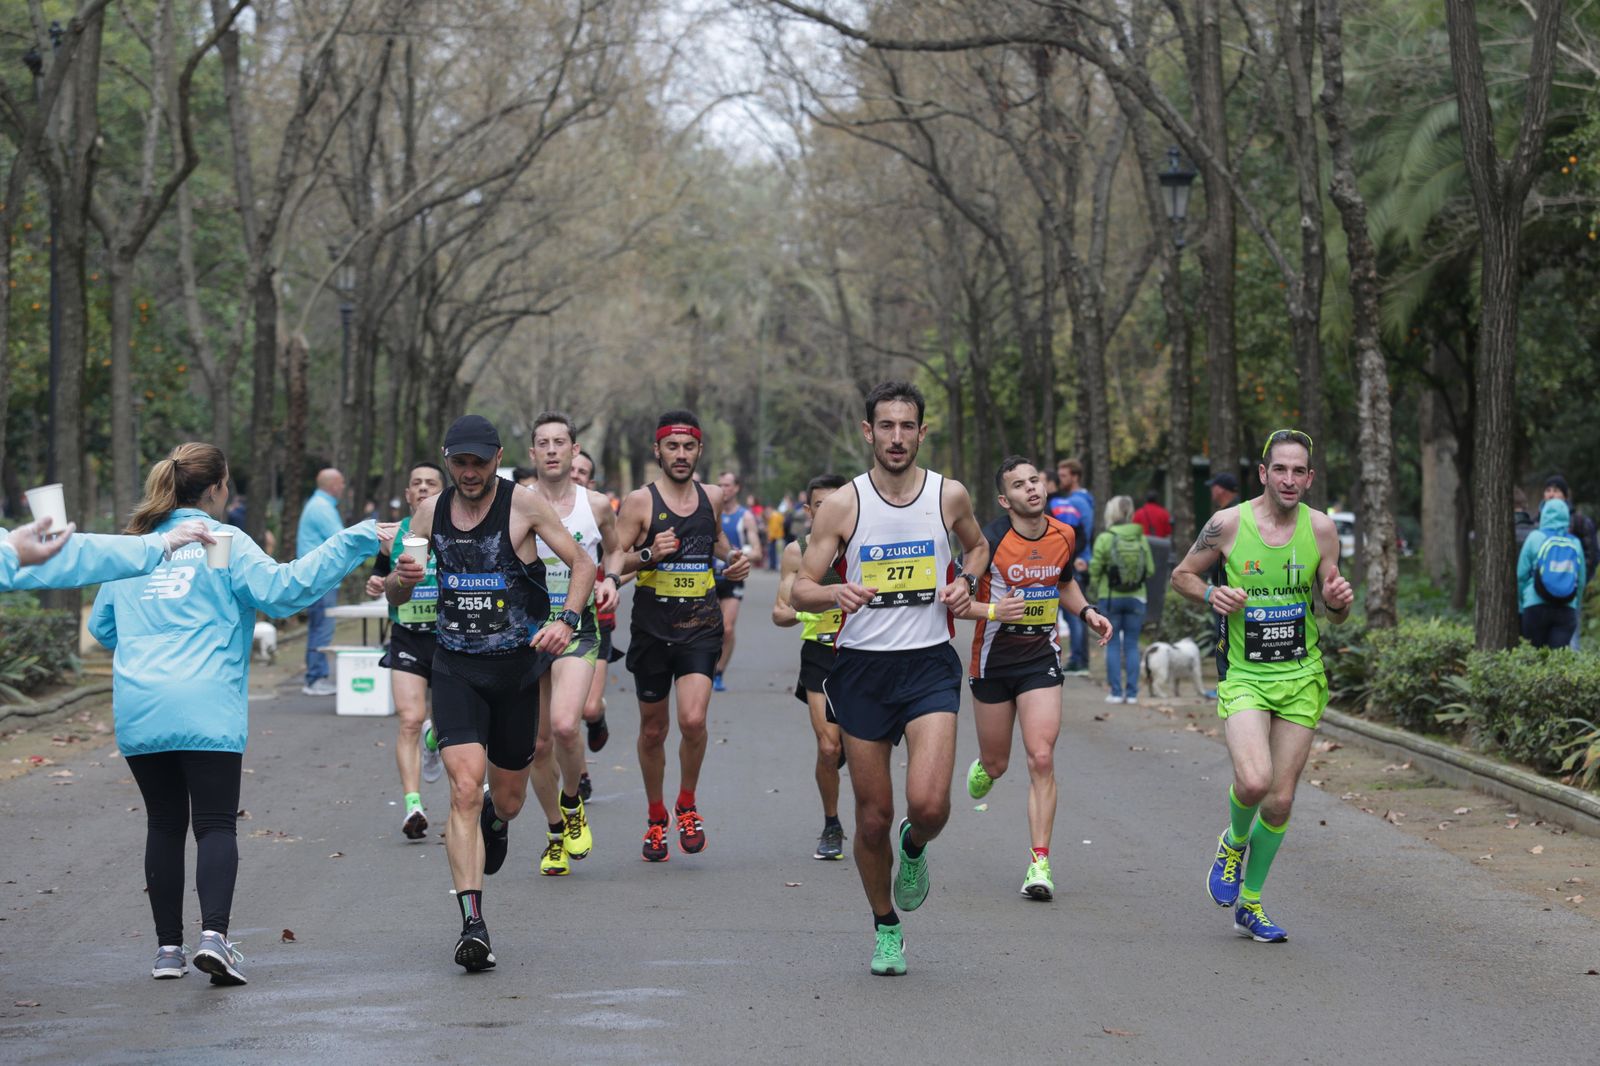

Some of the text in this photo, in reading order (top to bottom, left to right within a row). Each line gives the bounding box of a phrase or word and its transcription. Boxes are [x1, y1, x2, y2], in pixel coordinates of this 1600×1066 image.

[886, 545, 926, 557] ZURICH
[675, 562, 705, 570] ZURICH
[887, 565, 914, 581] 277
[461, 578, 498, 587] ZURICH
[673, 578, 695, 588] 335
[414, 590, 439, 598] ZURIC
[1026, 590, 1055, 598] ZURICH
[457, 596, 492, 610] 2554
[1024, 605, 1044, 616] 406
[1262, 625, 1295, 640] 2555
